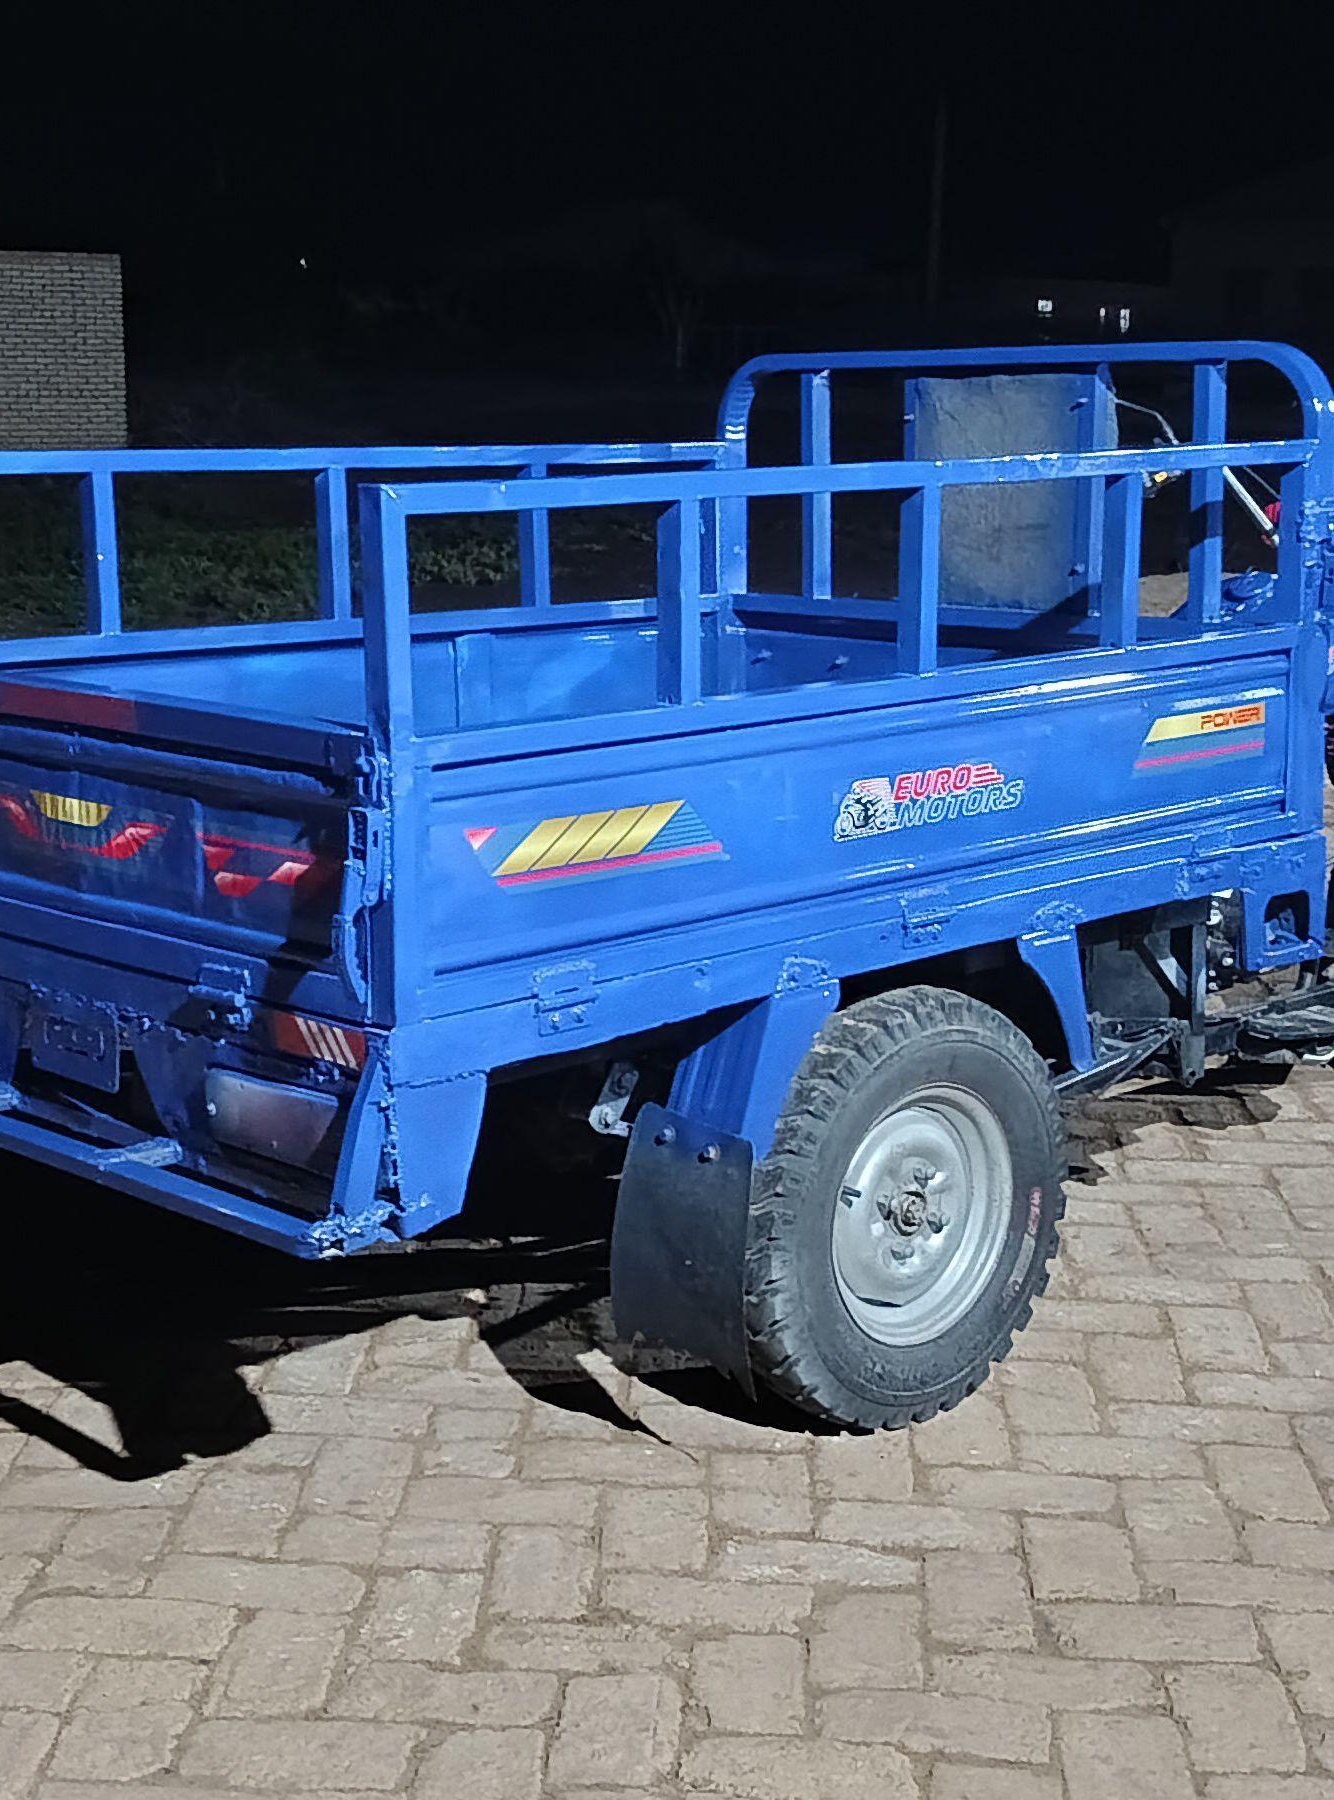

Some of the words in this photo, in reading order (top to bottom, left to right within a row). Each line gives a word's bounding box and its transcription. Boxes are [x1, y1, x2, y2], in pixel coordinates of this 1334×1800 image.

[1200, 706, 1261, 730] POWER
[893, 763, 972, 801] EURO
[898, 779, 1024, 829] MOTORS
